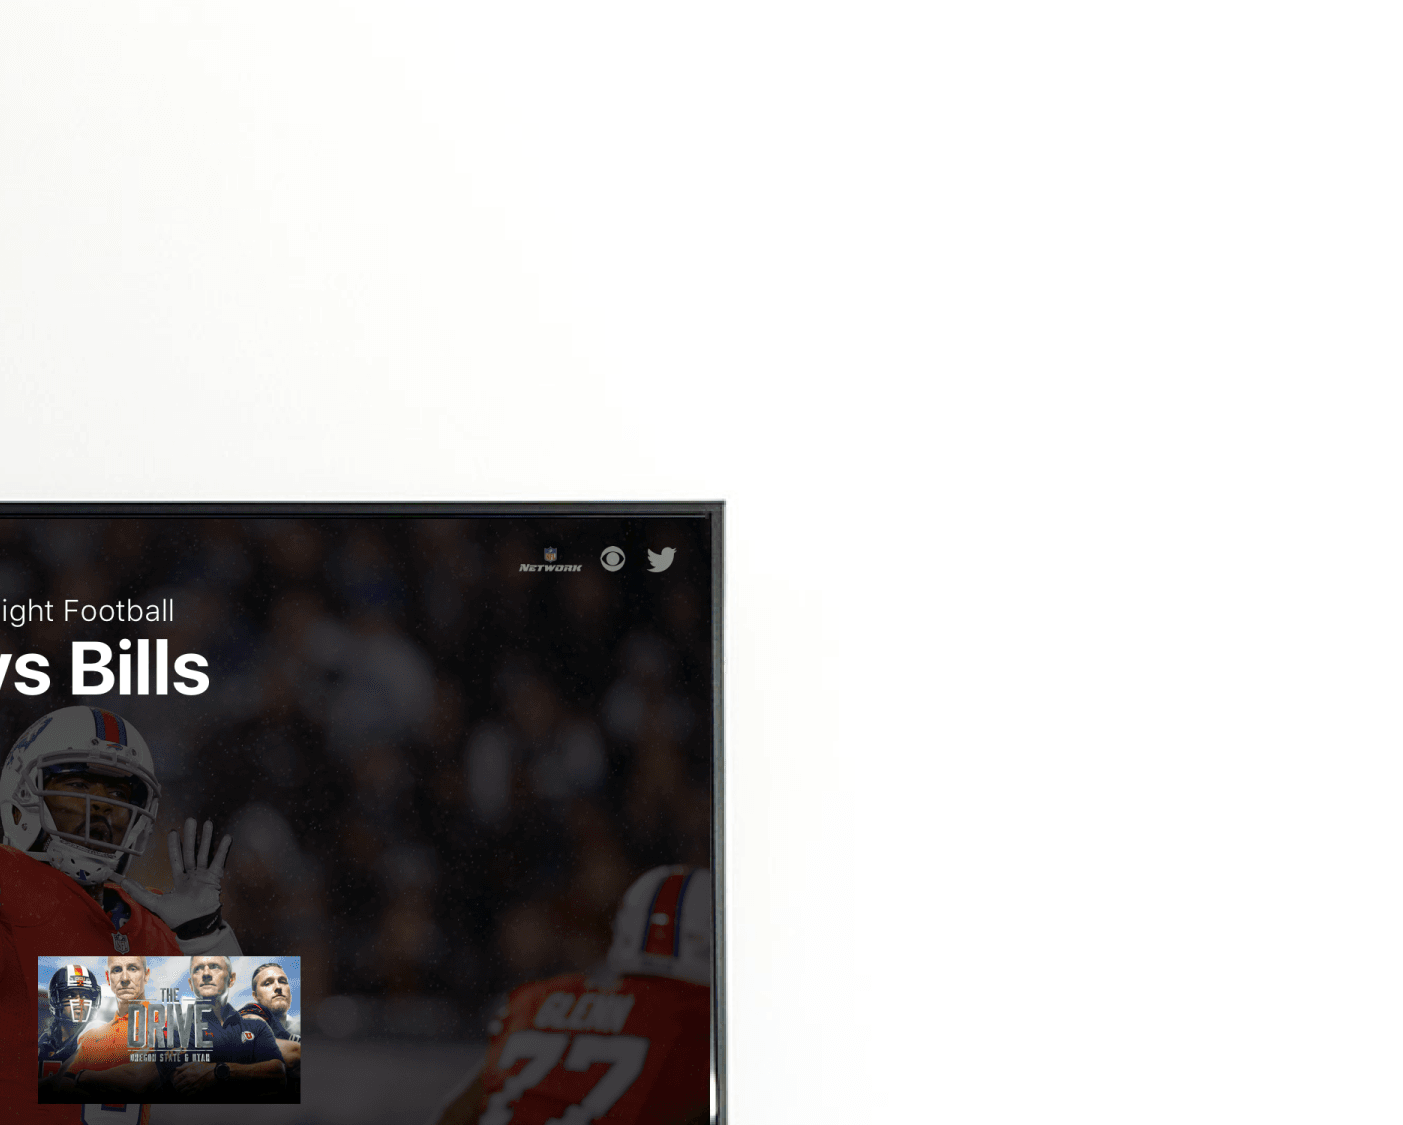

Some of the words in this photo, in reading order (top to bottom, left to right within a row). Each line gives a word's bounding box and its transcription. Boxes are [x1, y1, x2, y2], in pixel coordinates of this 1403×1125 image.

[518, 563, 583, 573] NETWORK
[64, 598, 174, 622] Football
[72, 638, 210, 696] Bills
[160, 988, 180, 1003] THE
[127, 1003, 214, 1048] DRIVE
[160, 1053, 181, 1063] STATE
[192, 1053, 211, 1063] UTAH
